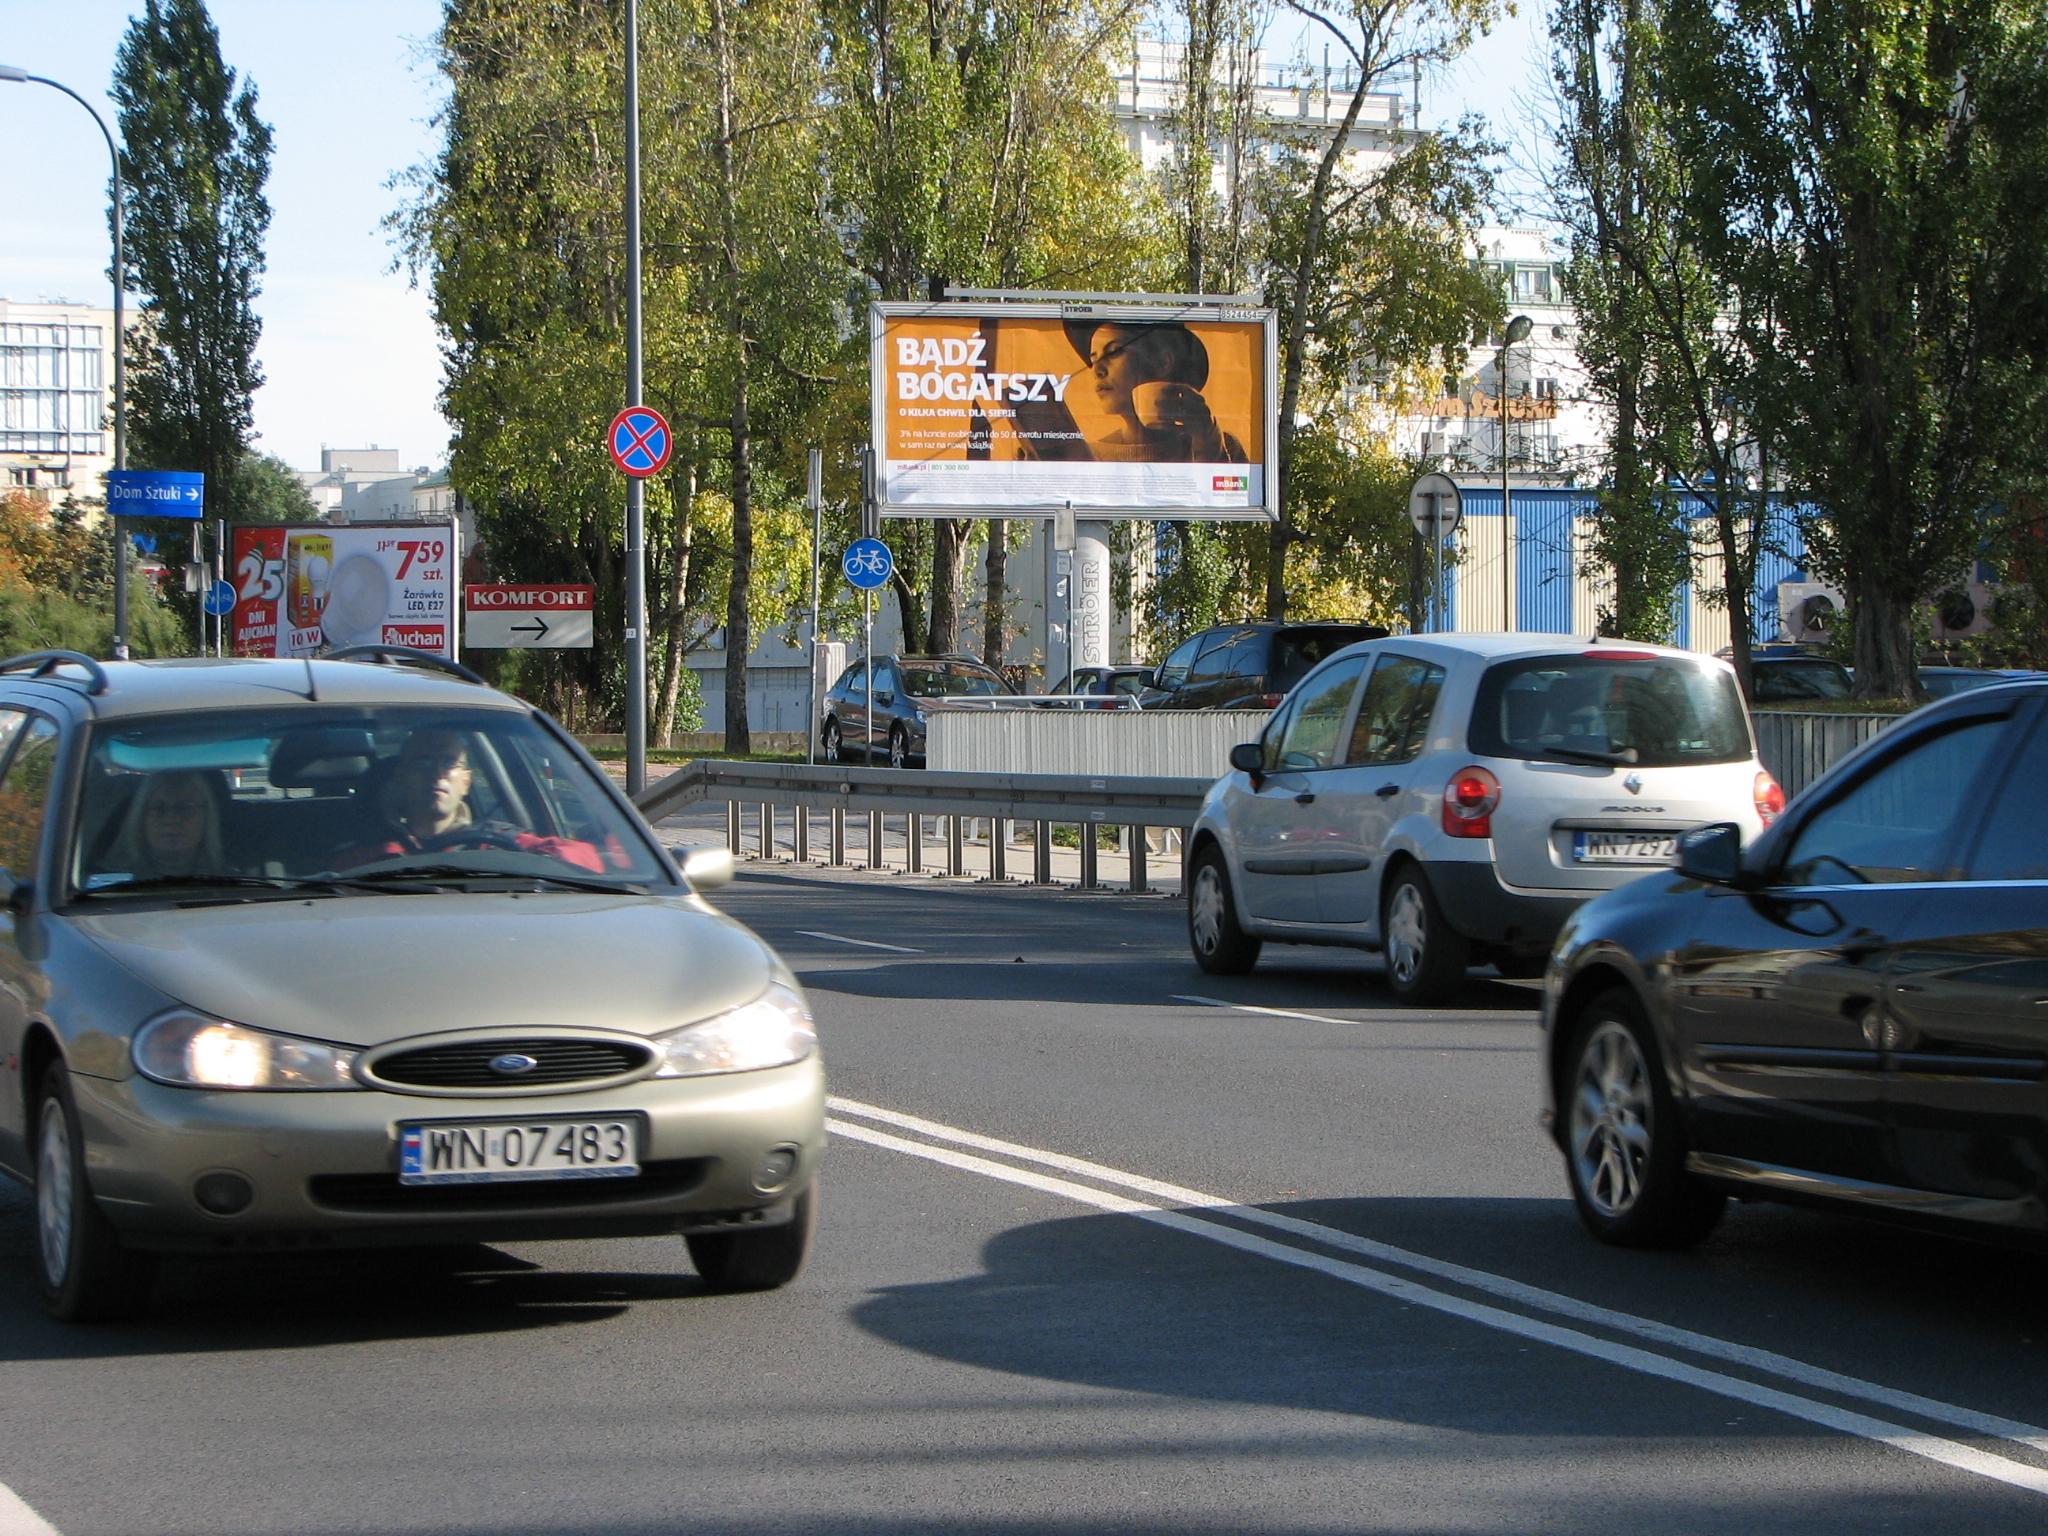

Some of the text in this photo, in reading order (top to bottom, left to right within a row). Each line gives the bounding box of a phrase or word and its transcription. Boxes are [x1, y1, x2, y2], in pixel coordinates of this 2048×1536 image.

[896, 331, 987, 374] BĄDŹ
[896, 371, 1072, 402] BOGATSZY
[899, 407, 1017, 418] O KILKA CHWIL DLA SIEBIE
[989, 430, 999, 438] do
[1000, 430, 1009, 439] 50
[1018, 430, 1042, 439] zwrotu
[1215, 479, 1244, 488] mBank
[114, 485, 181, 500] Dom Sztuki
[238, 553, 284, 600] 25
[423, 567, 444, 580] szt.
[404, 587, 444, 599] Żarówka
[473, 590, 588, 605] KOMFORT
[408, 600, 444, 611] LED, E27
[1080, 561, 1100, 663] STRÖER
[248, 611, 266, 624] DNI
[239, 624, 276, 640] AUCHAN
[291, 630, 319, 646] 10 W
[1588, 834, 1676, 857] WN 7292
[430, 1122, 627, 1170] WN 07483
